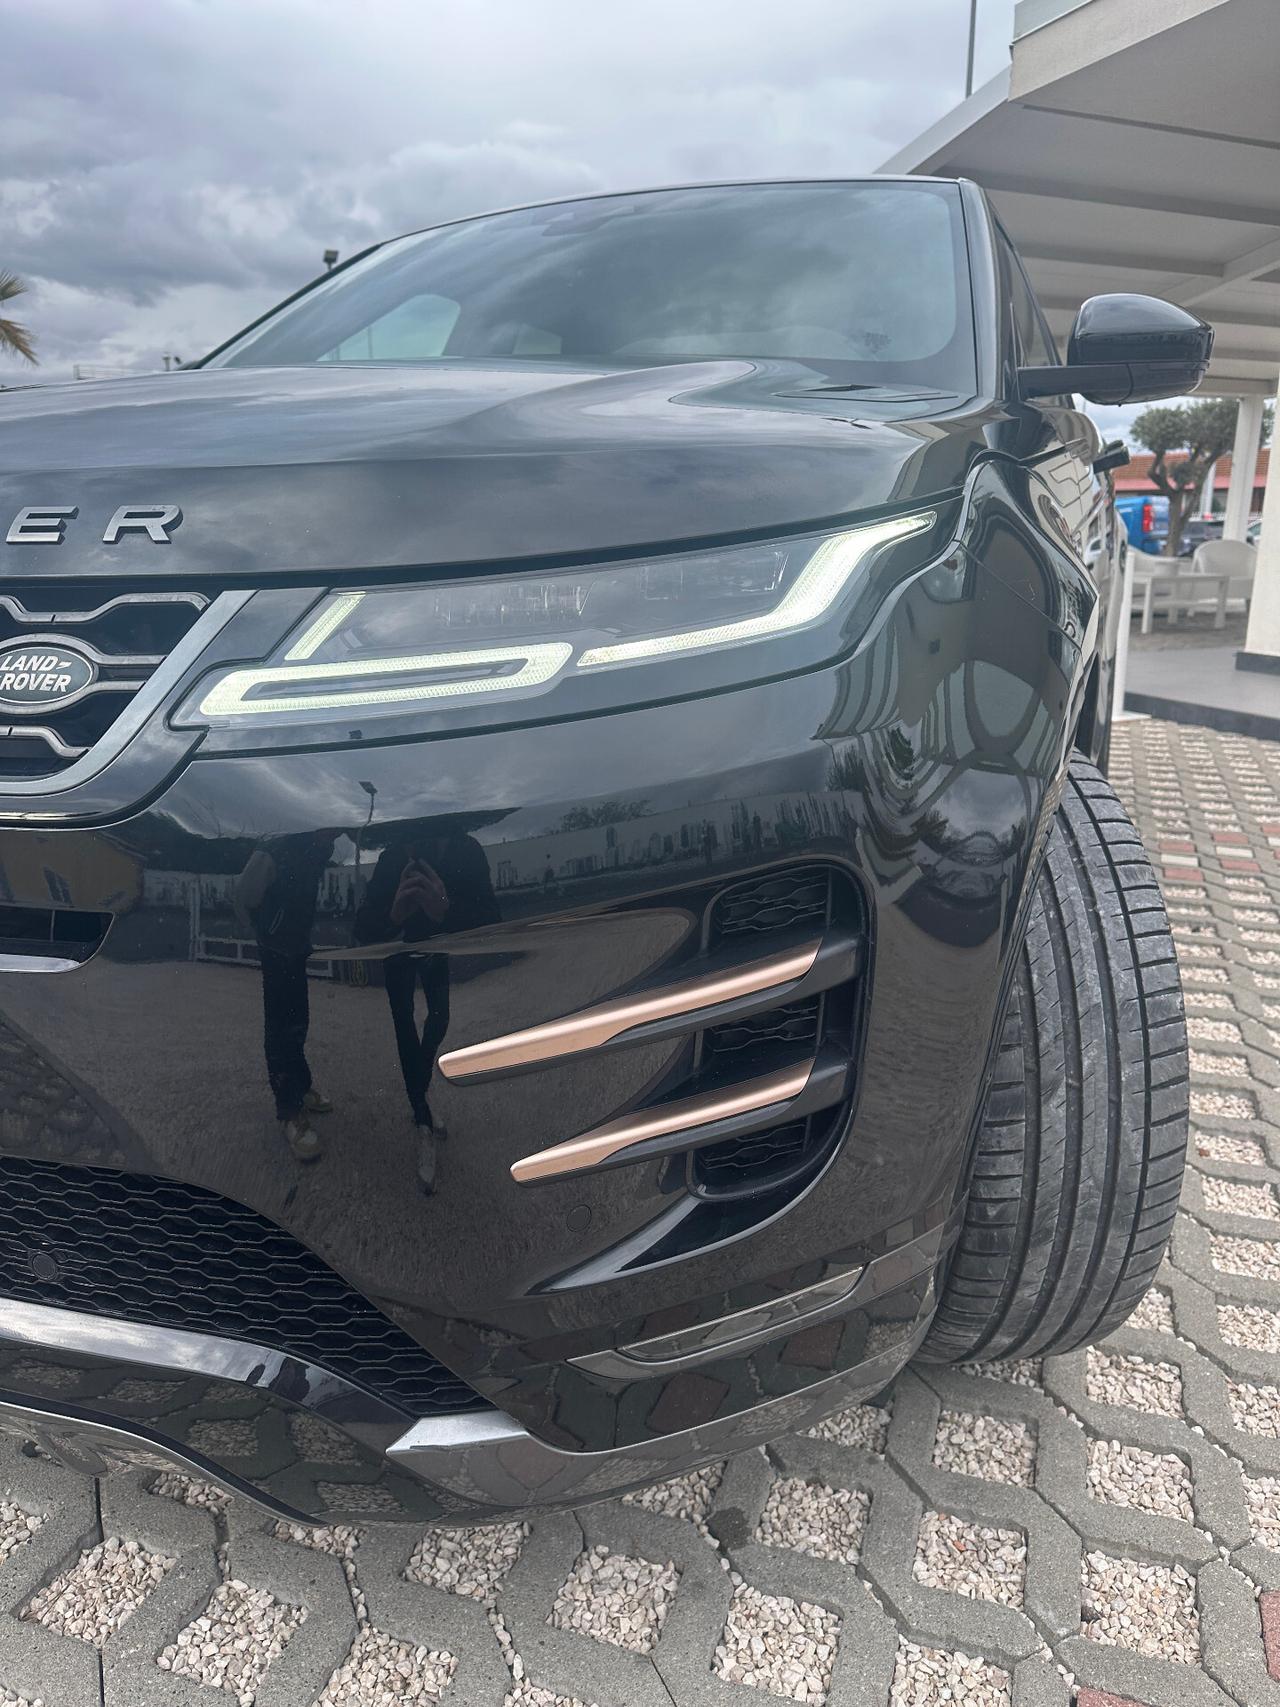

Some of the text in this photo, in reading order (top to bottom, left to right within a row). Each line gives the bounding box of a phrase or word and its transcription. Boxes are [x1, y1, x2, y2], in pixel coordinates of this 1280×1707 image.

[6, 504, 184, 545] ER
[0, 655, 59, 671] LAND
[0, 672, 72, 692] ROVER
